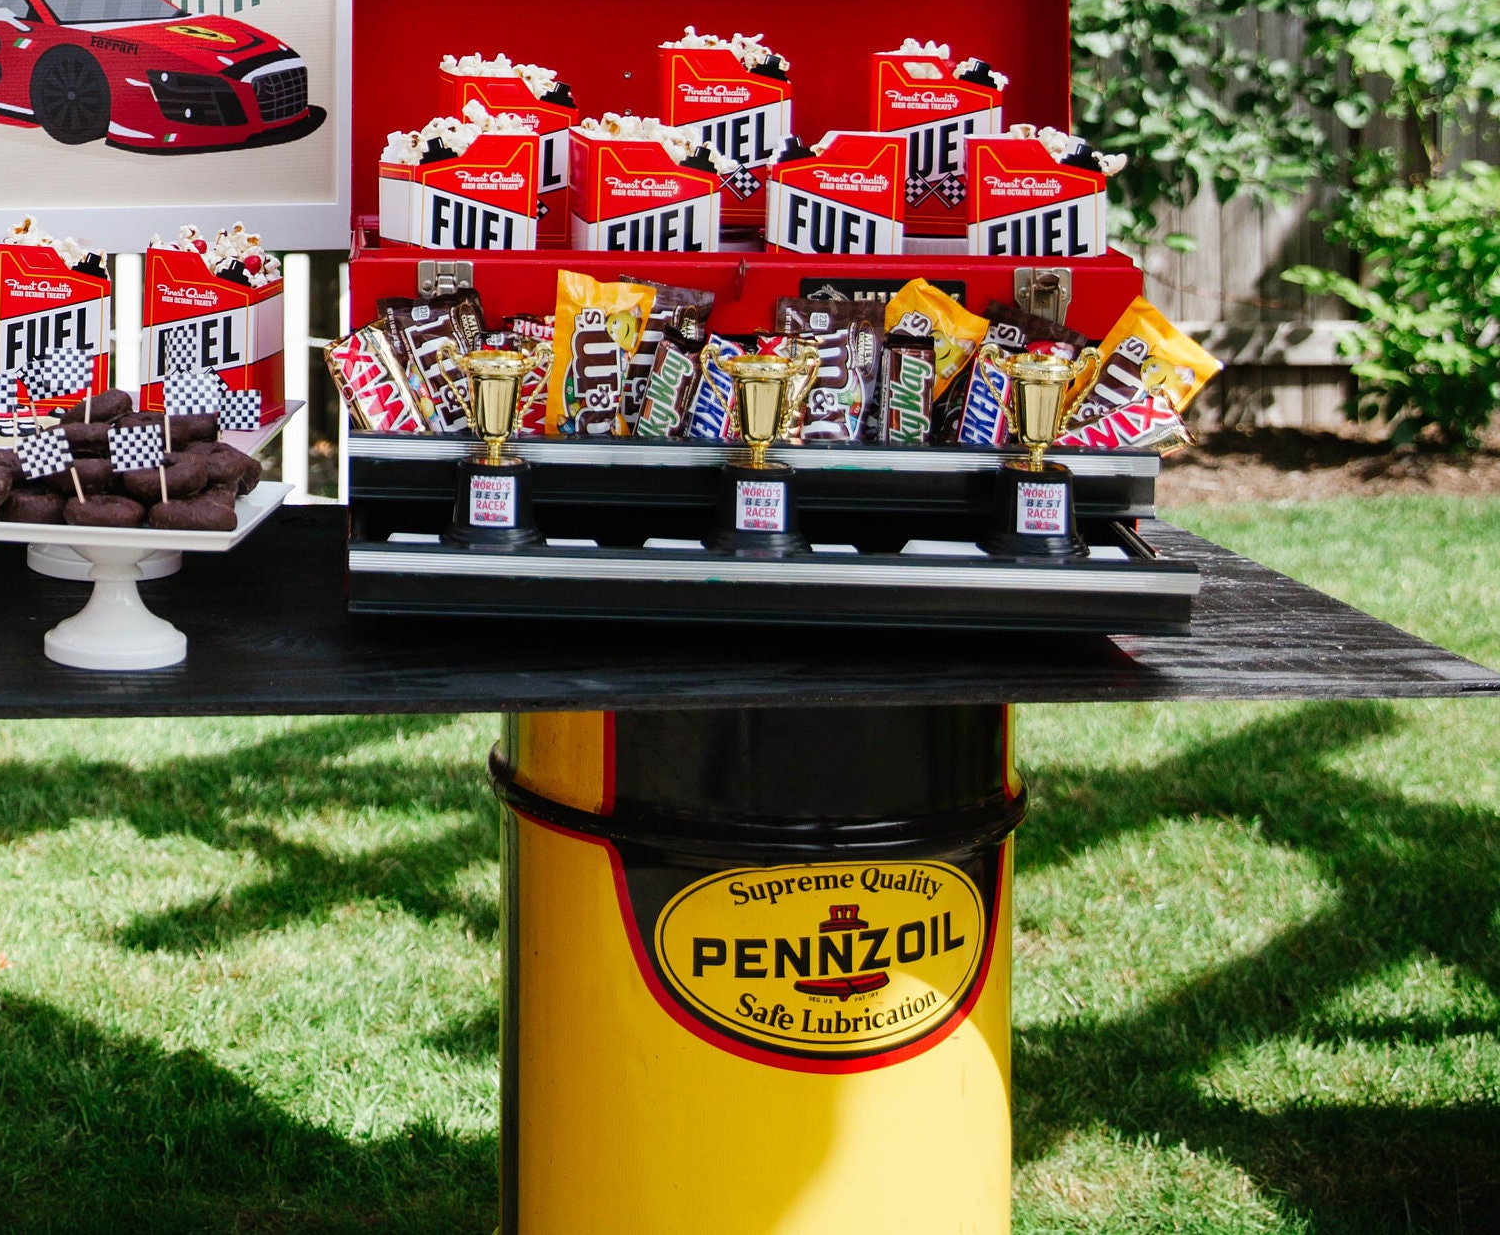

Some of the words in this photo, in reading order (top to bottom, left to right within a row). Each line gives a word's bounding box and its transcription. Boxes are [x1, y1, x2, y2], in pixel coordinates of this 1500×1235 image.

[90, 35, 141, 56] Ferrari
[678, 83, 713, 95] Finest
[713, 85, 751, 101] Quality
[885, 90, 921, 102] Finest
[921, 91, 959, 108] Quality
[702, 111, 774, 165] UEL
[455, 171, 489, 182] Finest
[489, 171, 525, 188] Quality
[604, 176, 641, 189] Finest
[641, 178, 680, 194] Quality
[813, 170, 850, 183] Finest
[850, 172, 889, 190] Quality
[983, 176, 1021, 188] Finest
[1021, 177, 1062, 194] Quality
[988, 204, 1088, 256] FUEL
[4, 279, 37, 290] Finest
[37, 281, 72, 297] Quality
[157, 284, 185, 295] Finest
[185, 287, 218, 305] Quality
[6, 307, 94, 370] FUEL
[513, 319, 555, 340] RIGH
[157, 315, 240, 377] FEL
[865, 333, 874, 365] MILK
[332, 335, 418, 431] WIX
[473, 480, 511, 491] WORLD'S
[742, 487, 781, 497] WORLD'S
[1023, 488, 1062, 498] WORLD'S
[475, 491, 510, 500] BEST
[745, 497, 780, 507] BEST
[1026, 498, 1061, 508] BEST
[476, 500, 506, 510] RACER
[746, 506, 776, 517] RACER
[1027, 508, 1058, 518] RACER
[728, 870, 854, 907] Supreme
[860, 867, 944, 901] Quality
[692, 910, 966, 979] PENNZOIL
[734, 992, 795, 1031] Safe
[801, 990, 938, 1034] Lubrication
